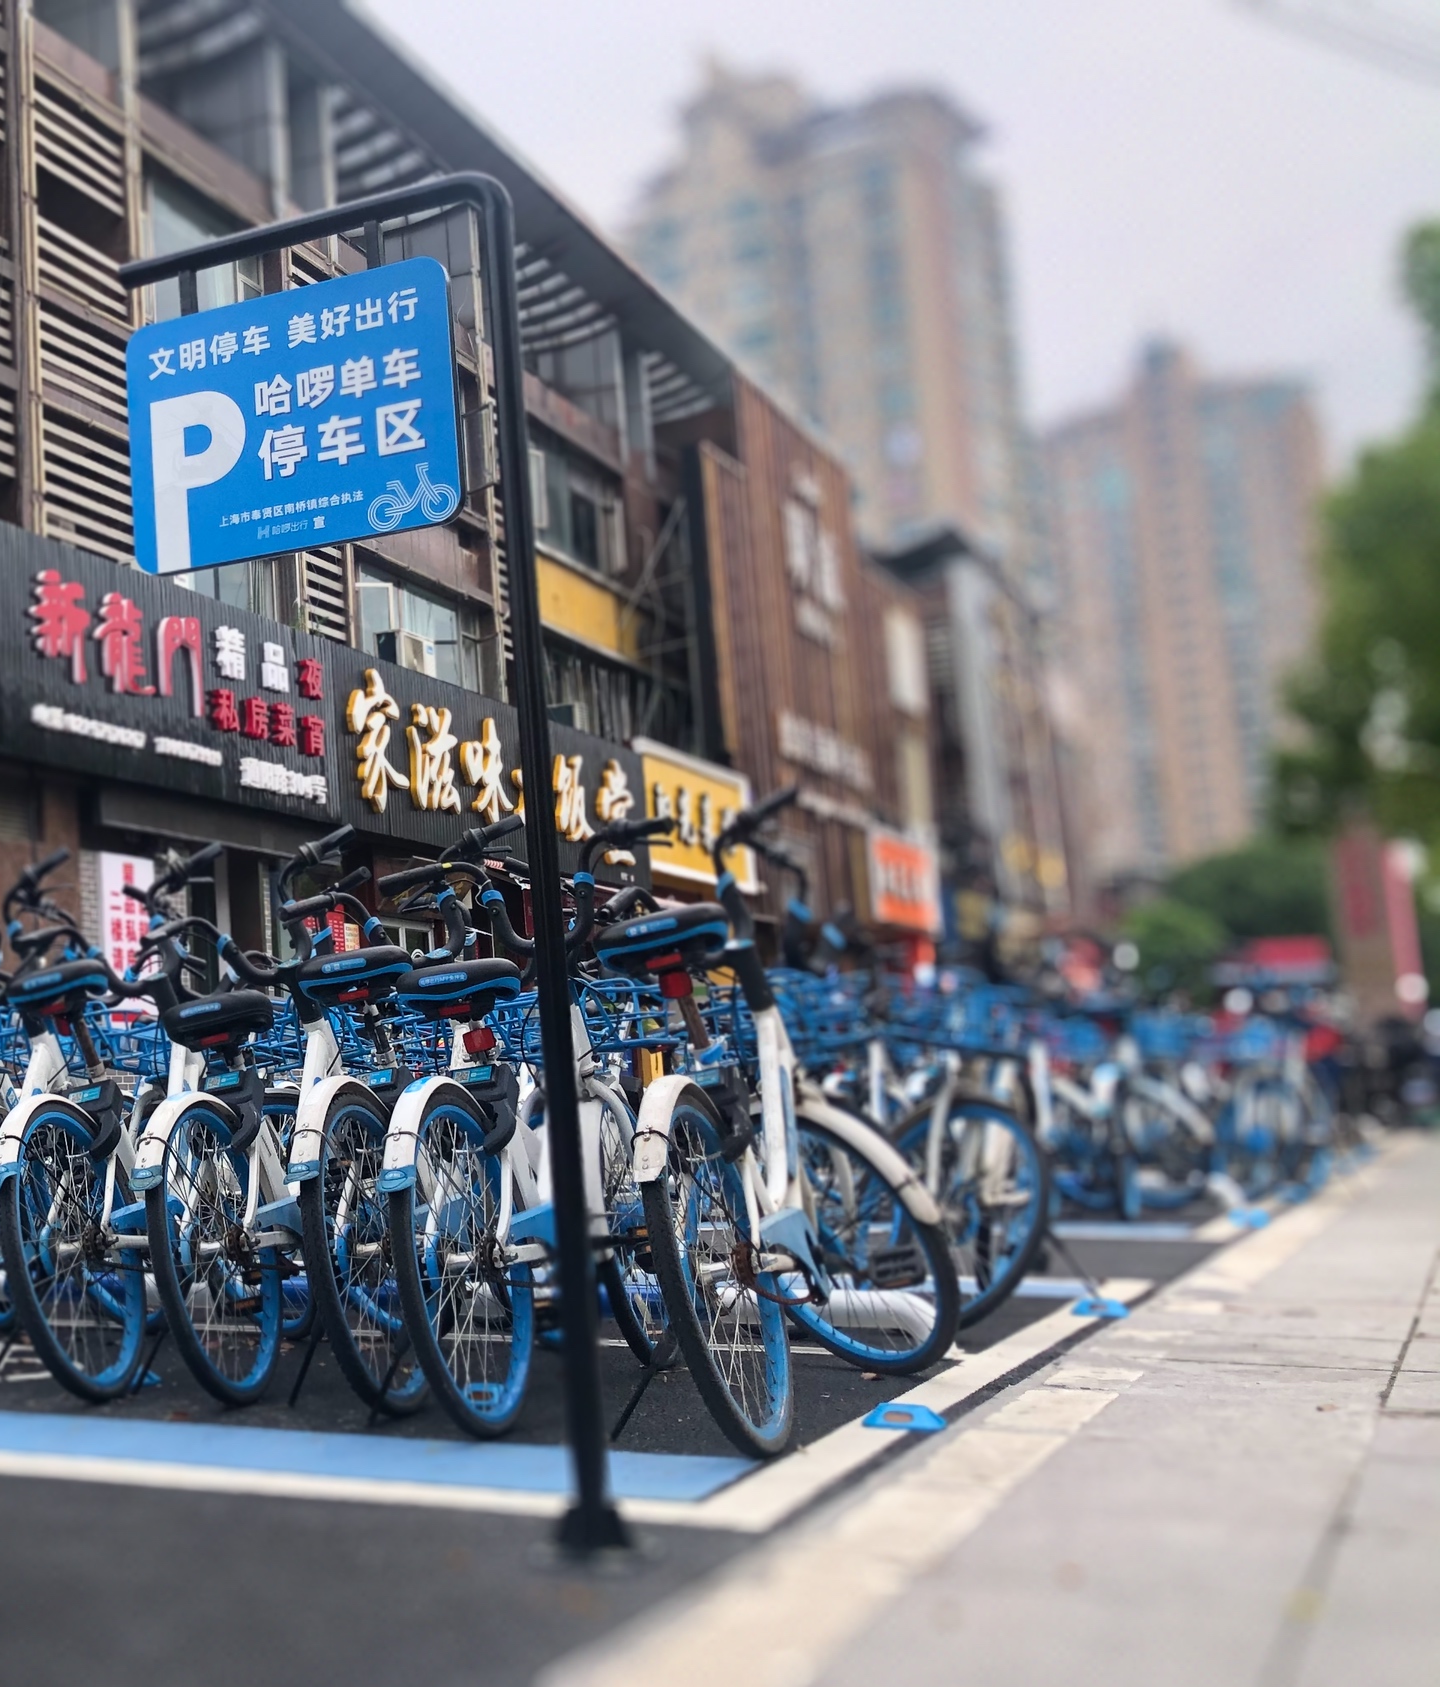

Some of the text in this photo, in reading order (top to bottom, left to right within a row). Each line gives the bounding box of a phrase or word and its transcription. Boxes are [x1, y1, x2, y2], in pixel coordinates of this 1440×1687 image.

[148, 287, 419, 381] 文明停车 美好出行
[254, 348, 422, 417] 哈啰单车
[257, 398, 426, 480] 停车区
[150, 390, 246, 574] P
[219, 490, 364, 527] 上海市奉贤区南桥镇综合执法
[271, 519, 308, 535] 哈啰出行
[313, 515, 326, 529] 宣
[215, 625, 290, 693] 精品
[211, 688, 296, 747] 私房菜
[299, 657, 326, 757] 夜宵
